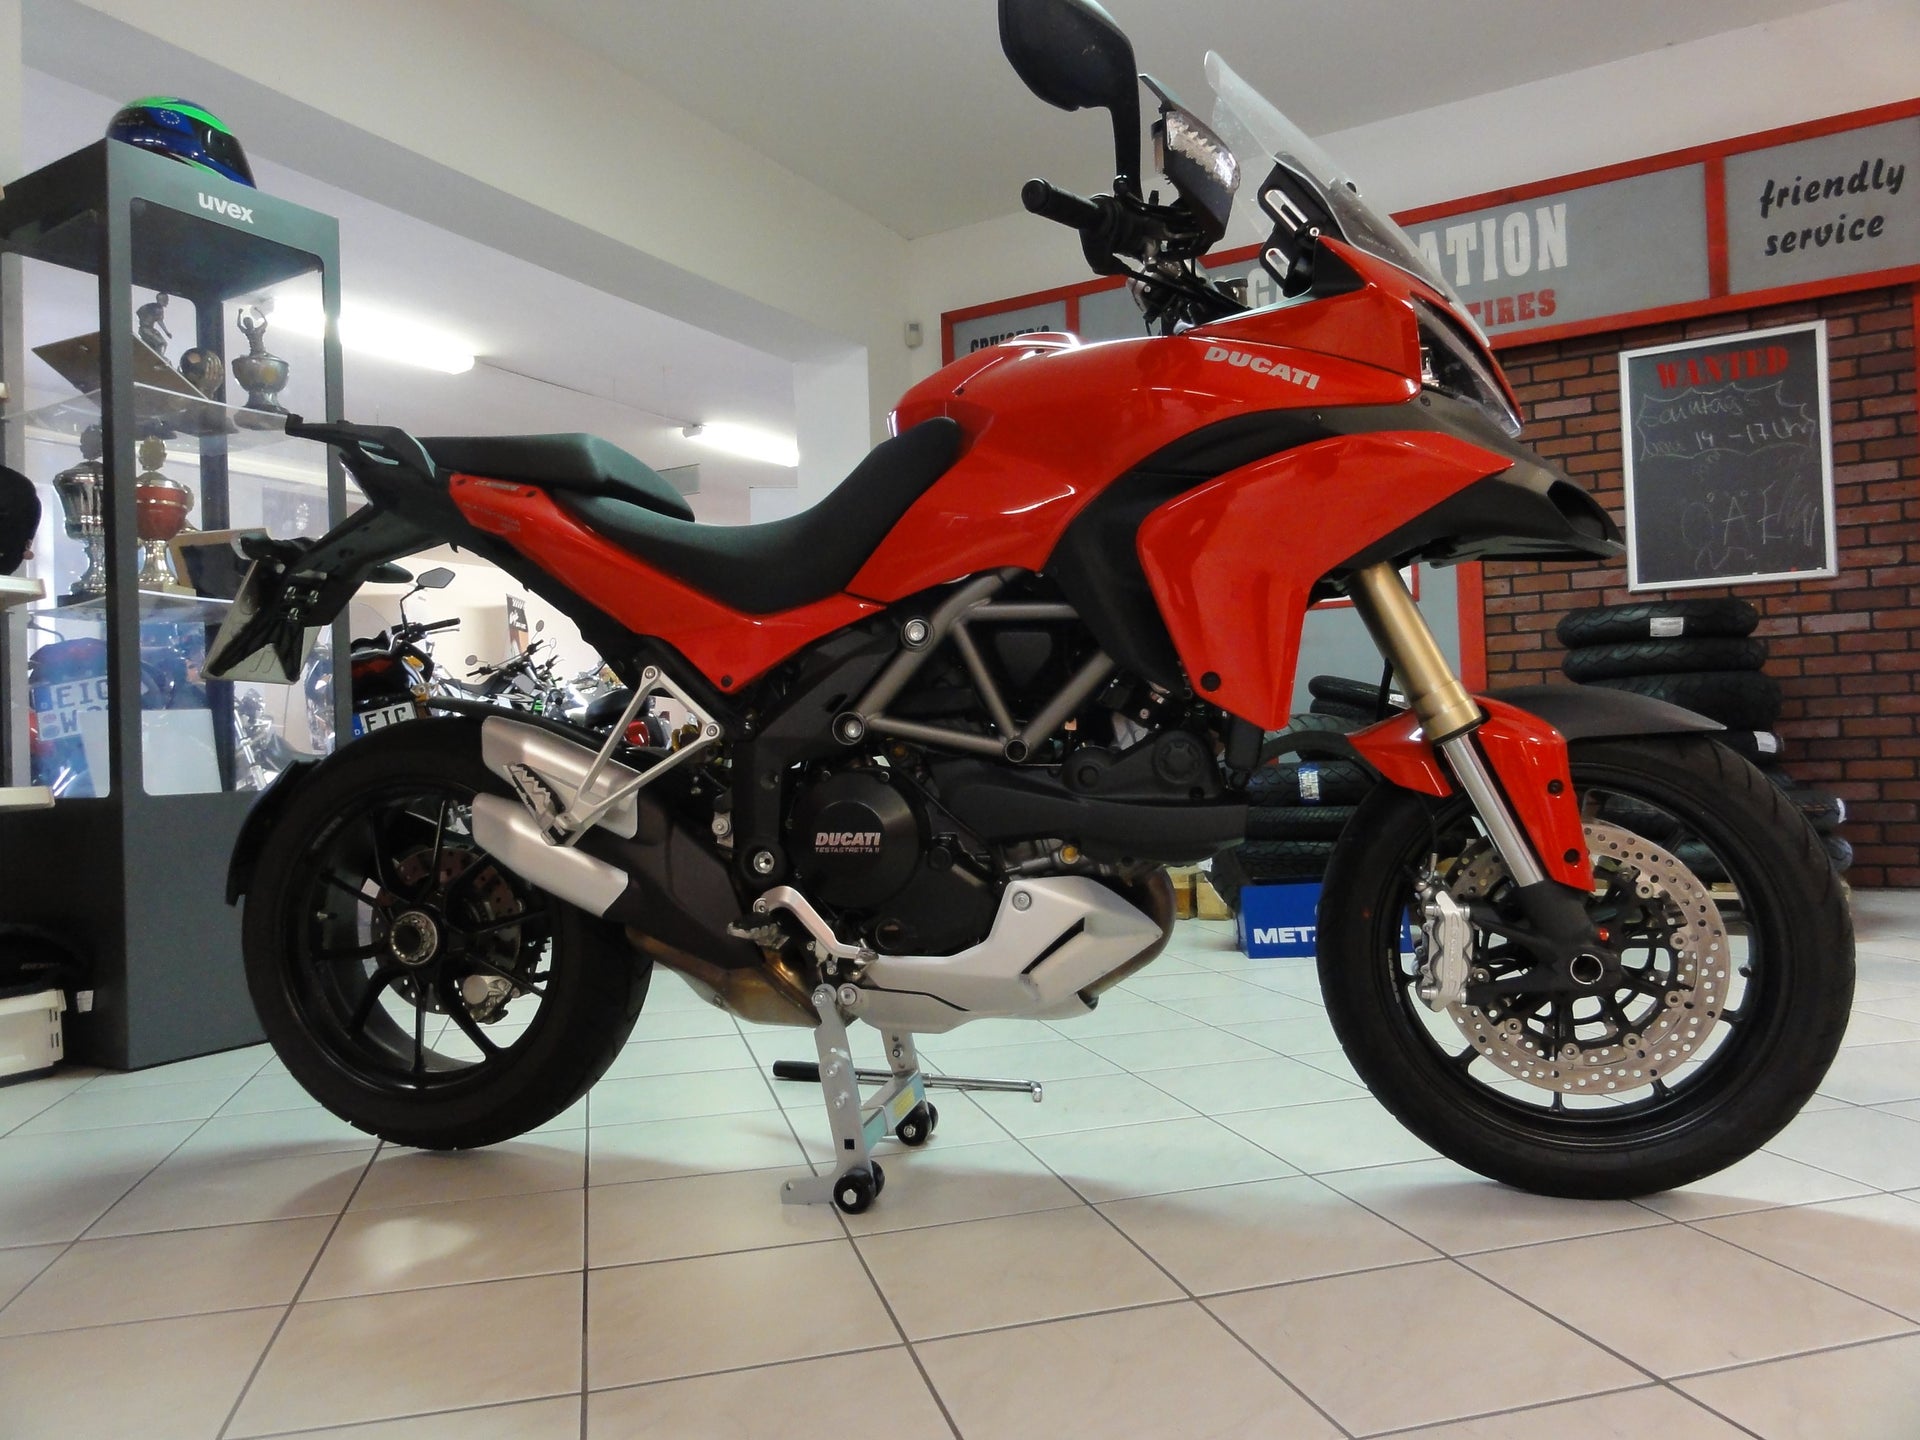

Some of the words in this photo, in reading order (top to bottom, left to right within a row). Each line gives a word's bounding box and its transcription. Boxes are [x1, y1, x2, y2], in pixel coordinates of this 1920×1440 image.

[198, 192, 254, 224] uvex
[1760, 158, 1905, 219] friendly
[1417, 203, 1568, 287] ATION
[1764, 213, 1885, 257] service
[1204, 346, 1320, 390] DUCATI
[1655, 345, 1789, 390] WANTED
[815, 832, 881, 846] DUCATI
[1253, 926, 1316, 944] MET
